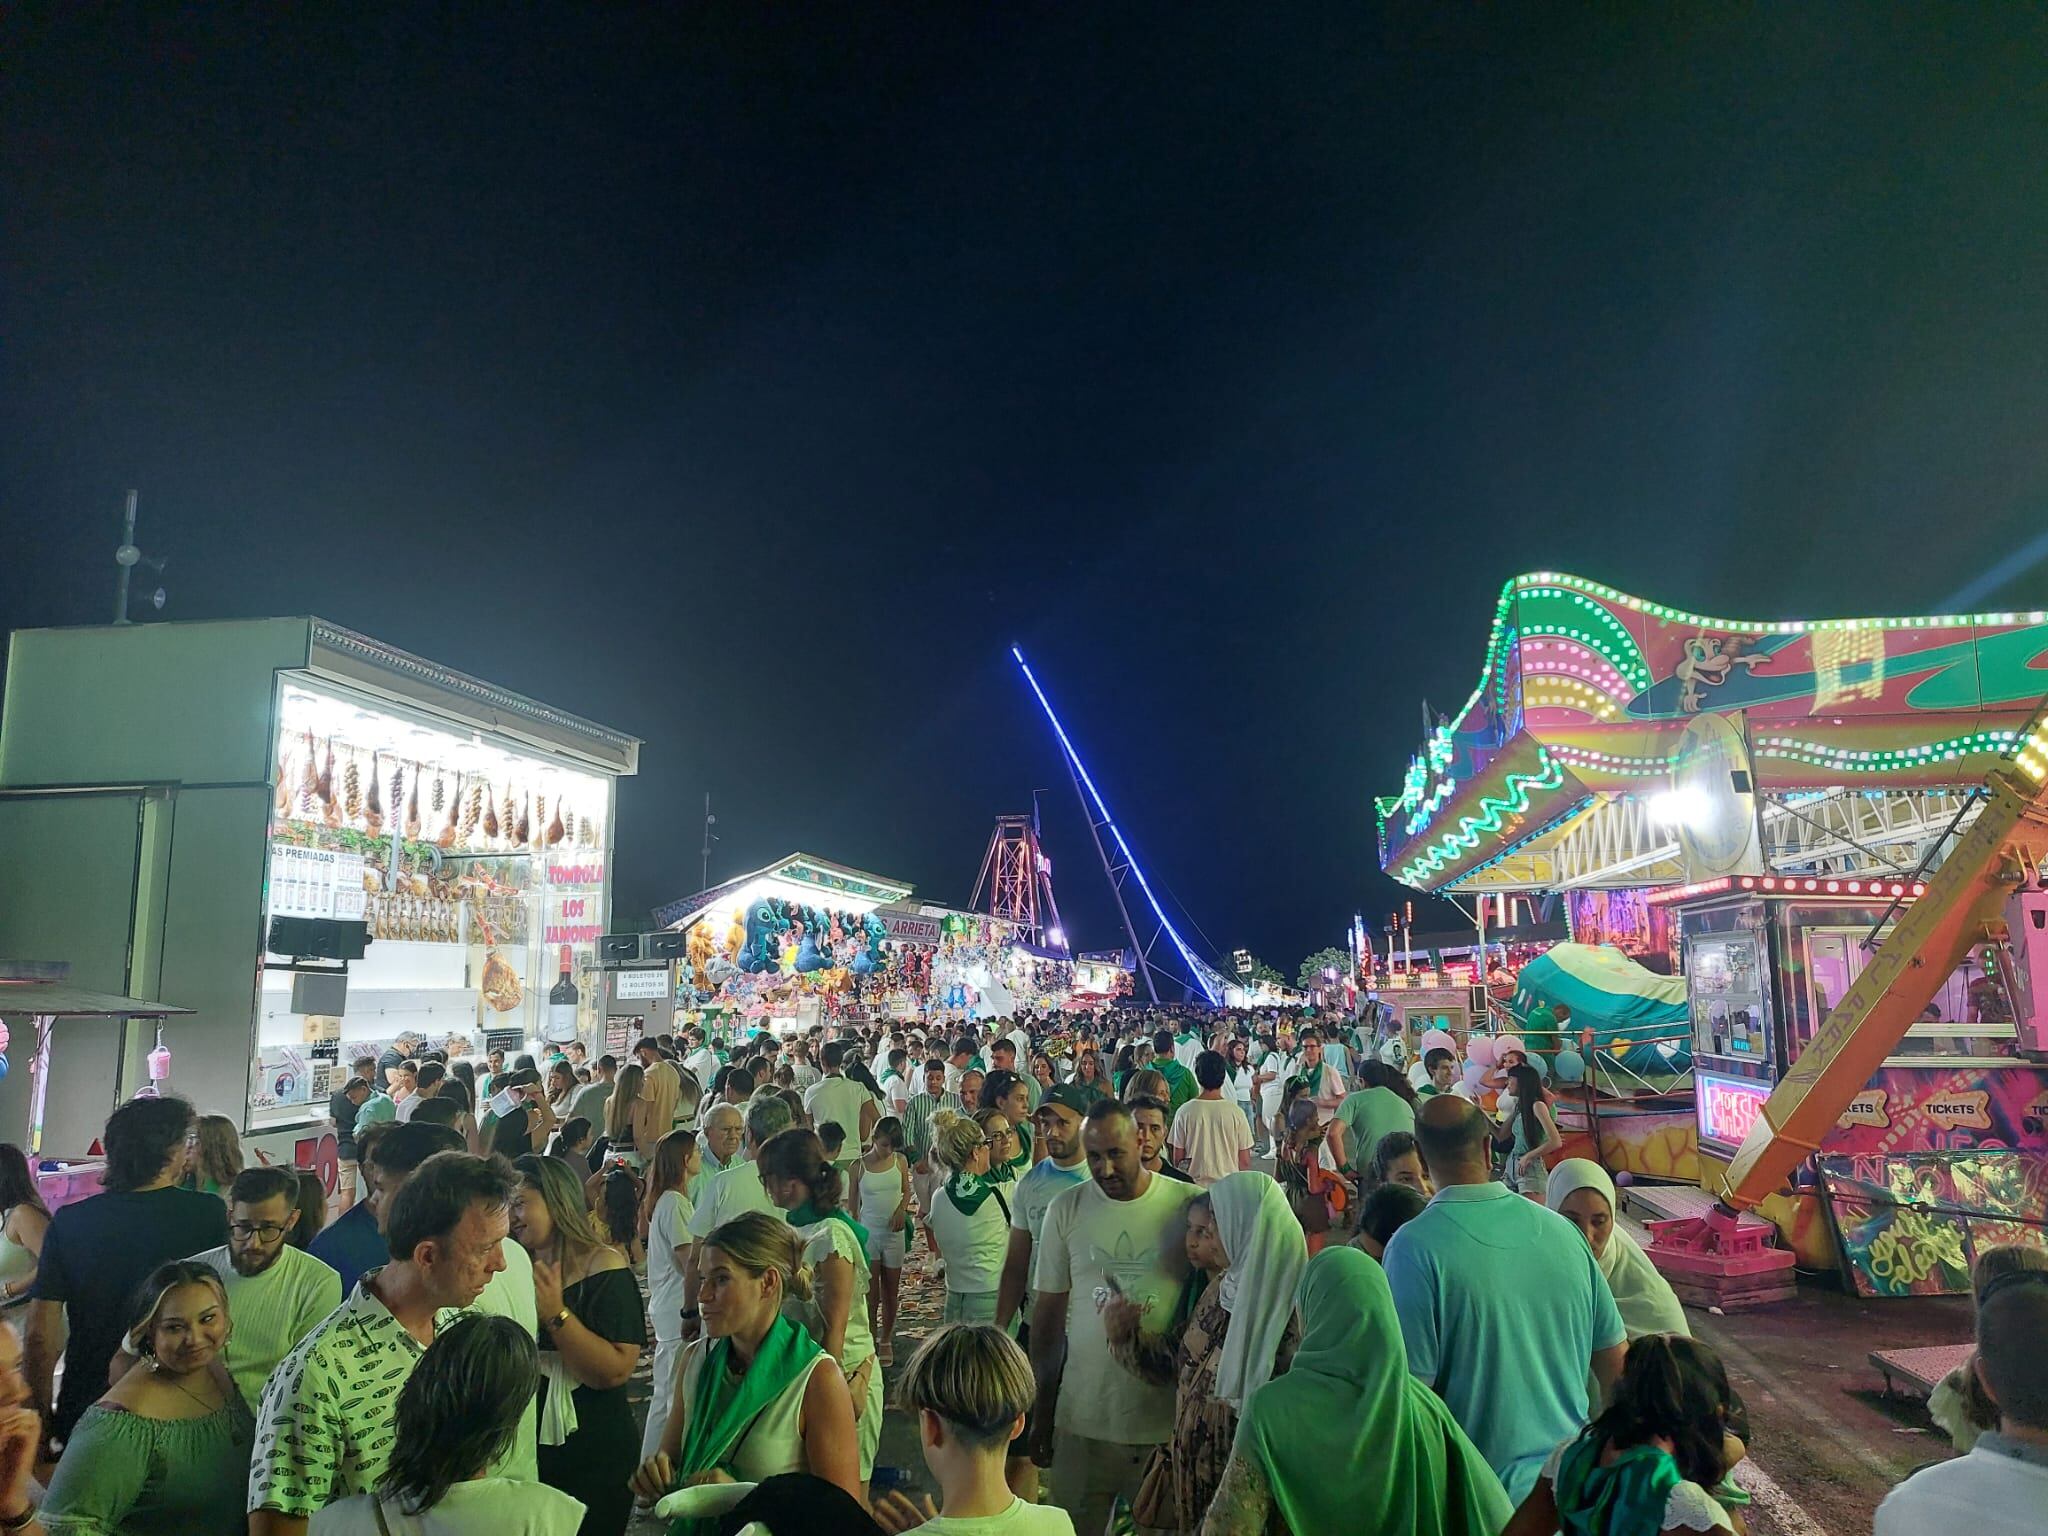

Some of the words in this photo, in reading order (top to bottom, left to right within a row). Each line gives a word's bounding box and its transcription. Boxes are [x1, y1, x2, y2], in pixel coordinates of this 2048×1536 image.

[272, 847, 283, 857] AS
[285, 848, 335, 864] PREMIADAS
[548, 865, 603, 884] TOMBOLA
[562, 899, 585, 918] LOS
[892, 919, 936, 937] ARRIETA
[1845, 1103, 1874, 1113] KETS
[1926, 1104, 1975, 1115] TICKETS
